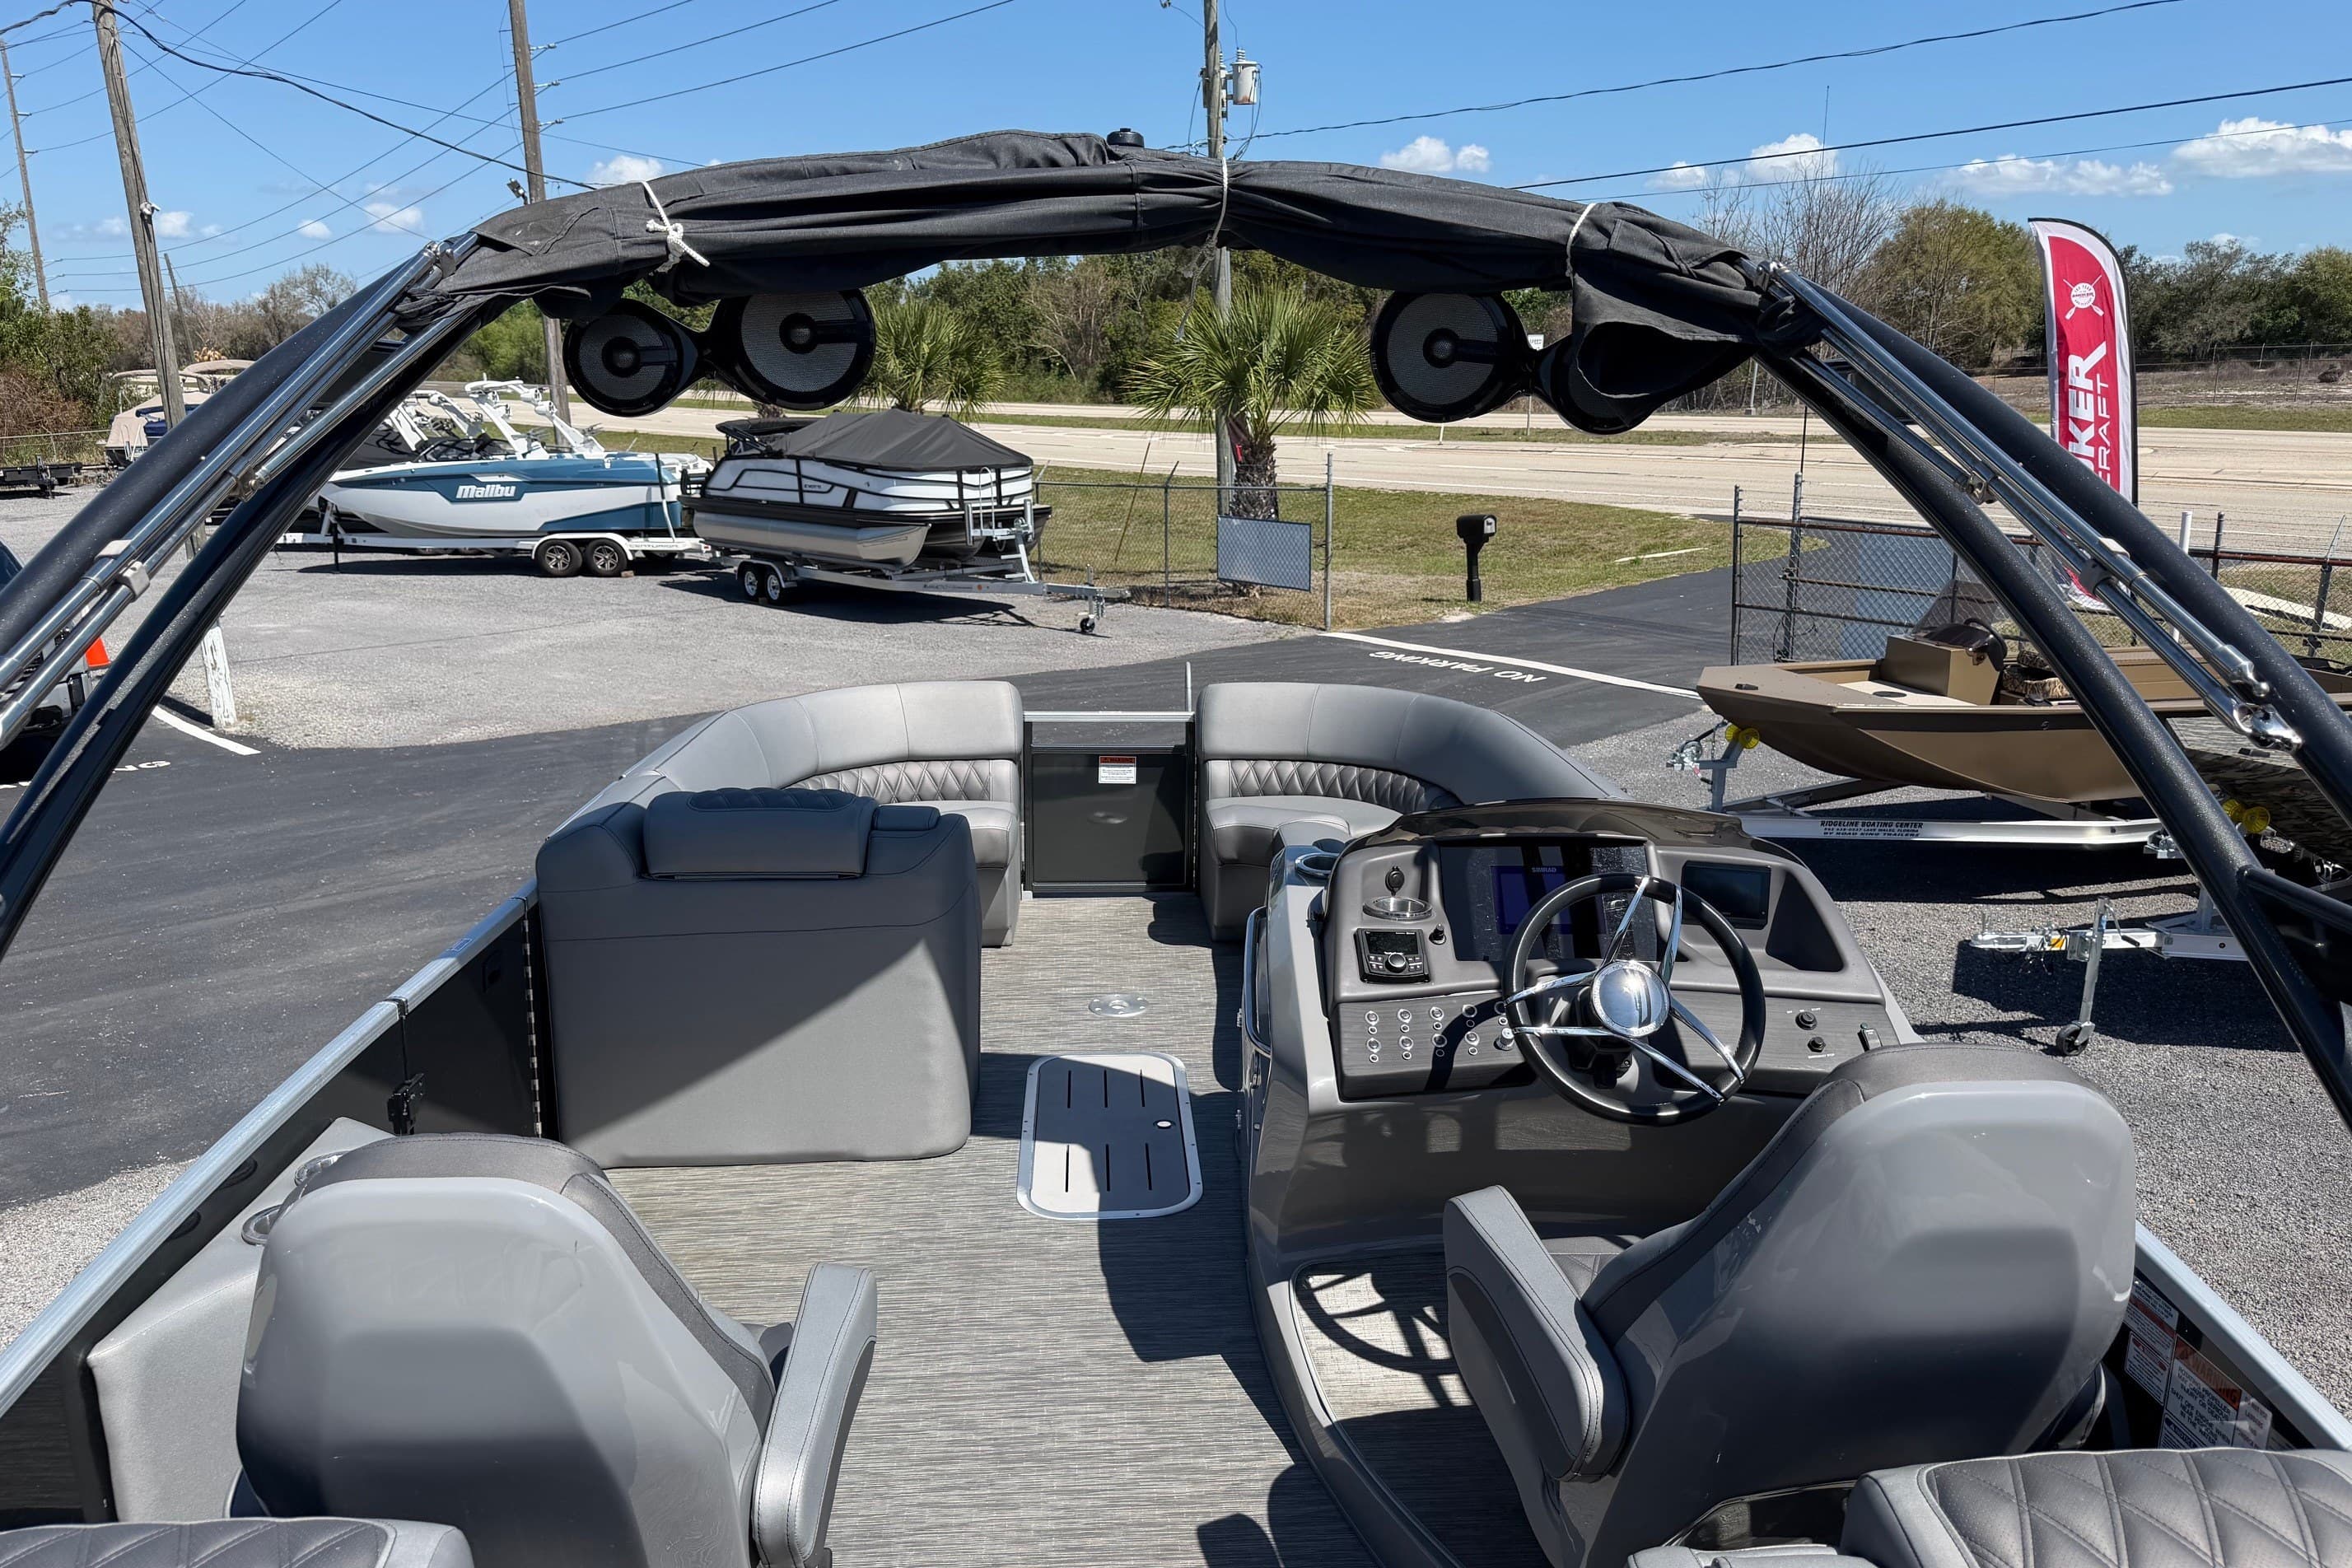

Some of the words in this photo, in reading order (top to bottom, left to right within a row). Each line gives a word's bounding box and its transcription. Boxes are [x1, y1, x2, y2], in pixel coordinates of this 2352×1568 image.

[2068, 341, 2107, 475] KER
[455, 484, 516, 499] Malibu
[1369, 651, 1494, 673] PARKING
[1494, 670, 1547, 683] NO
